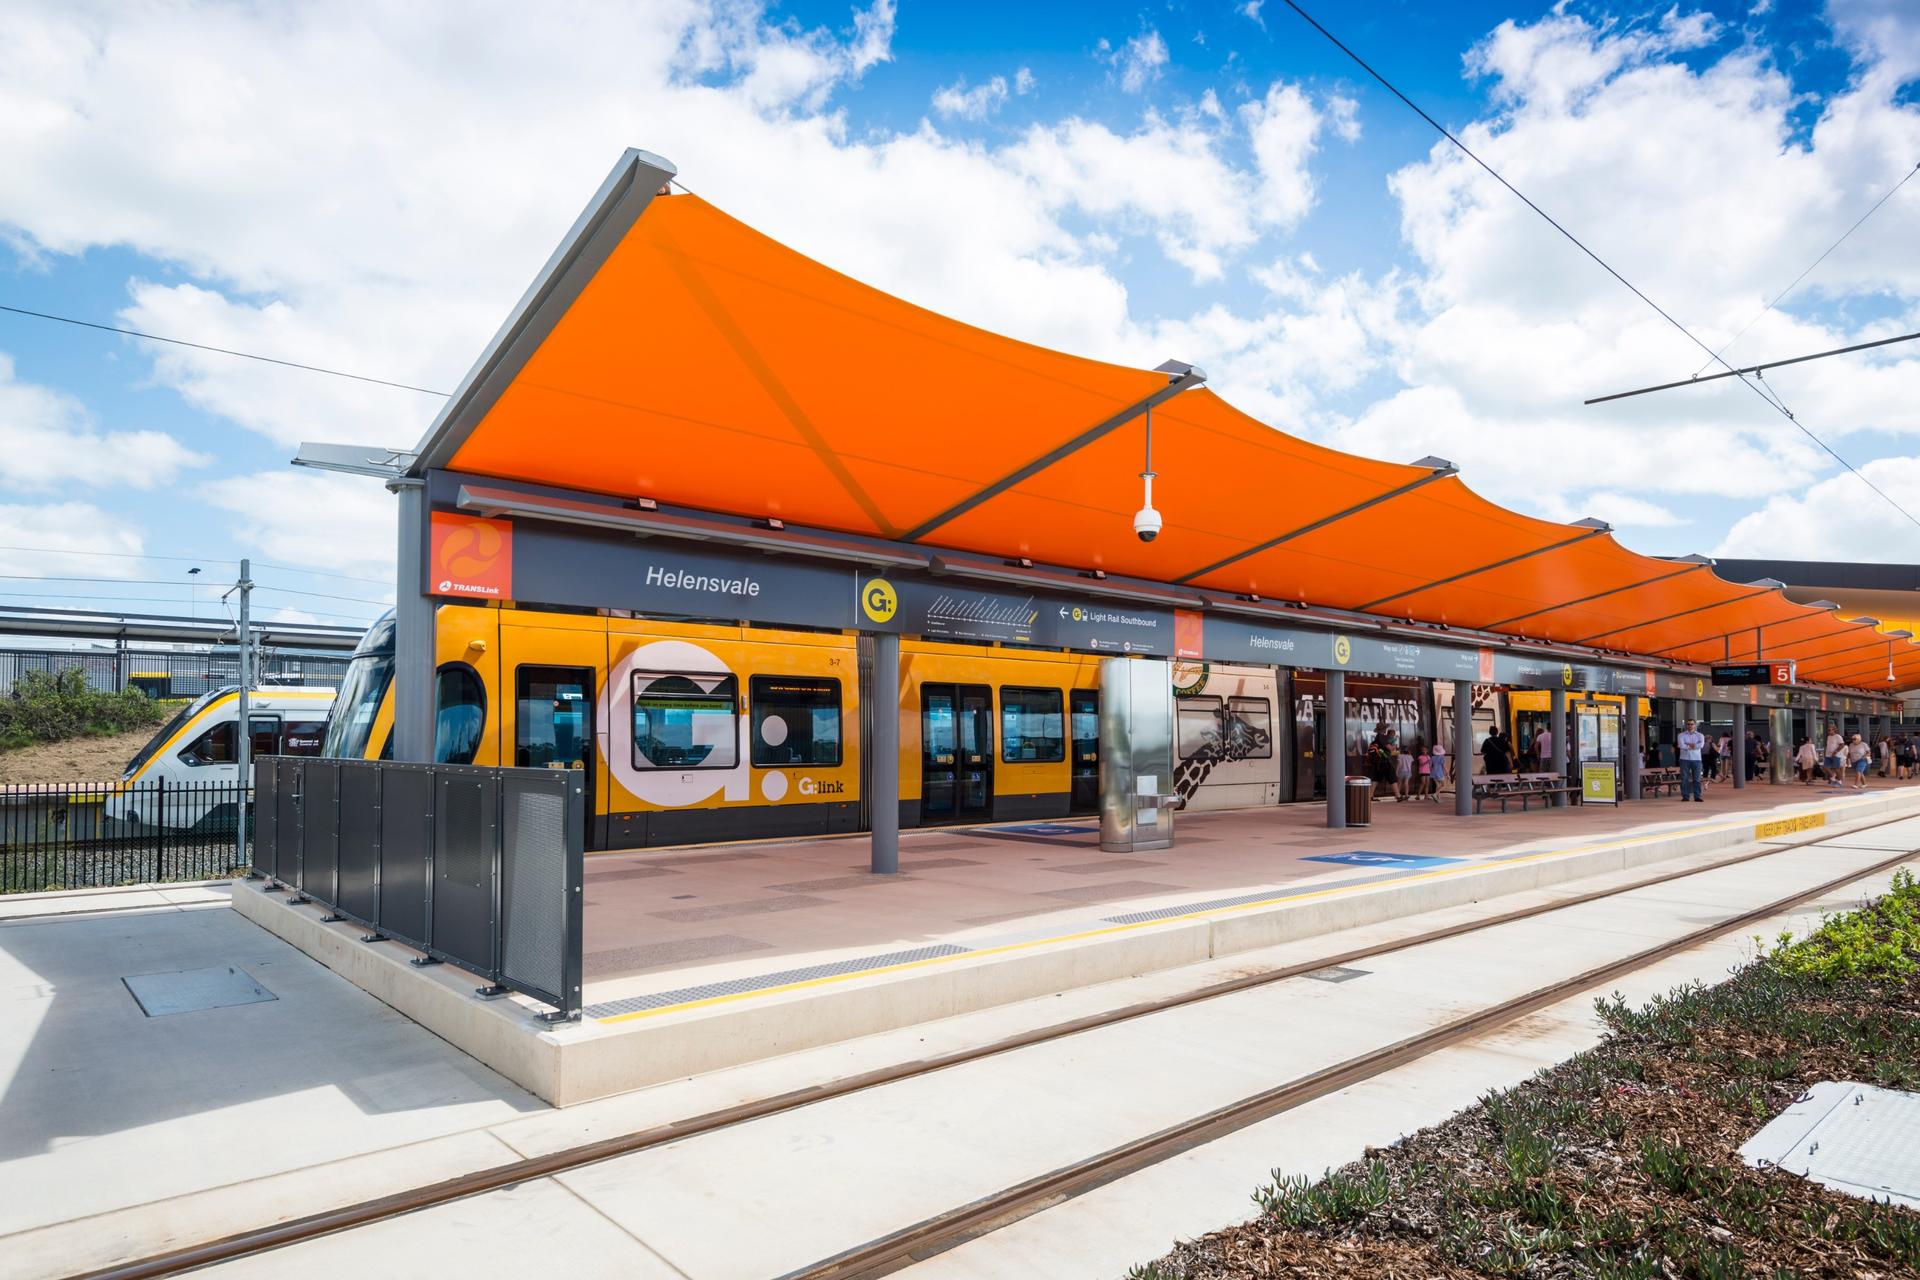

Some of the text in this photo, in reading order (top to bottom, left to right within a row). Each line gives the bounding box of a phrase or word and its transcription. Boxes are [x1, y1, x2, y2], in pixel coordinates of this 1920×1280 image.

[453, 583, 499, 594] TRANSLink
[646, 566, 760, 596] Helensvale
[1090, 611, 1106, 623] Light
[1107, 614, 1120, 623] Rail
[1120, 615, 1157, 628] Southbound
[1249, 634, 1294, 651] Helensvale
[1777, 668, 1788, 682] 5
